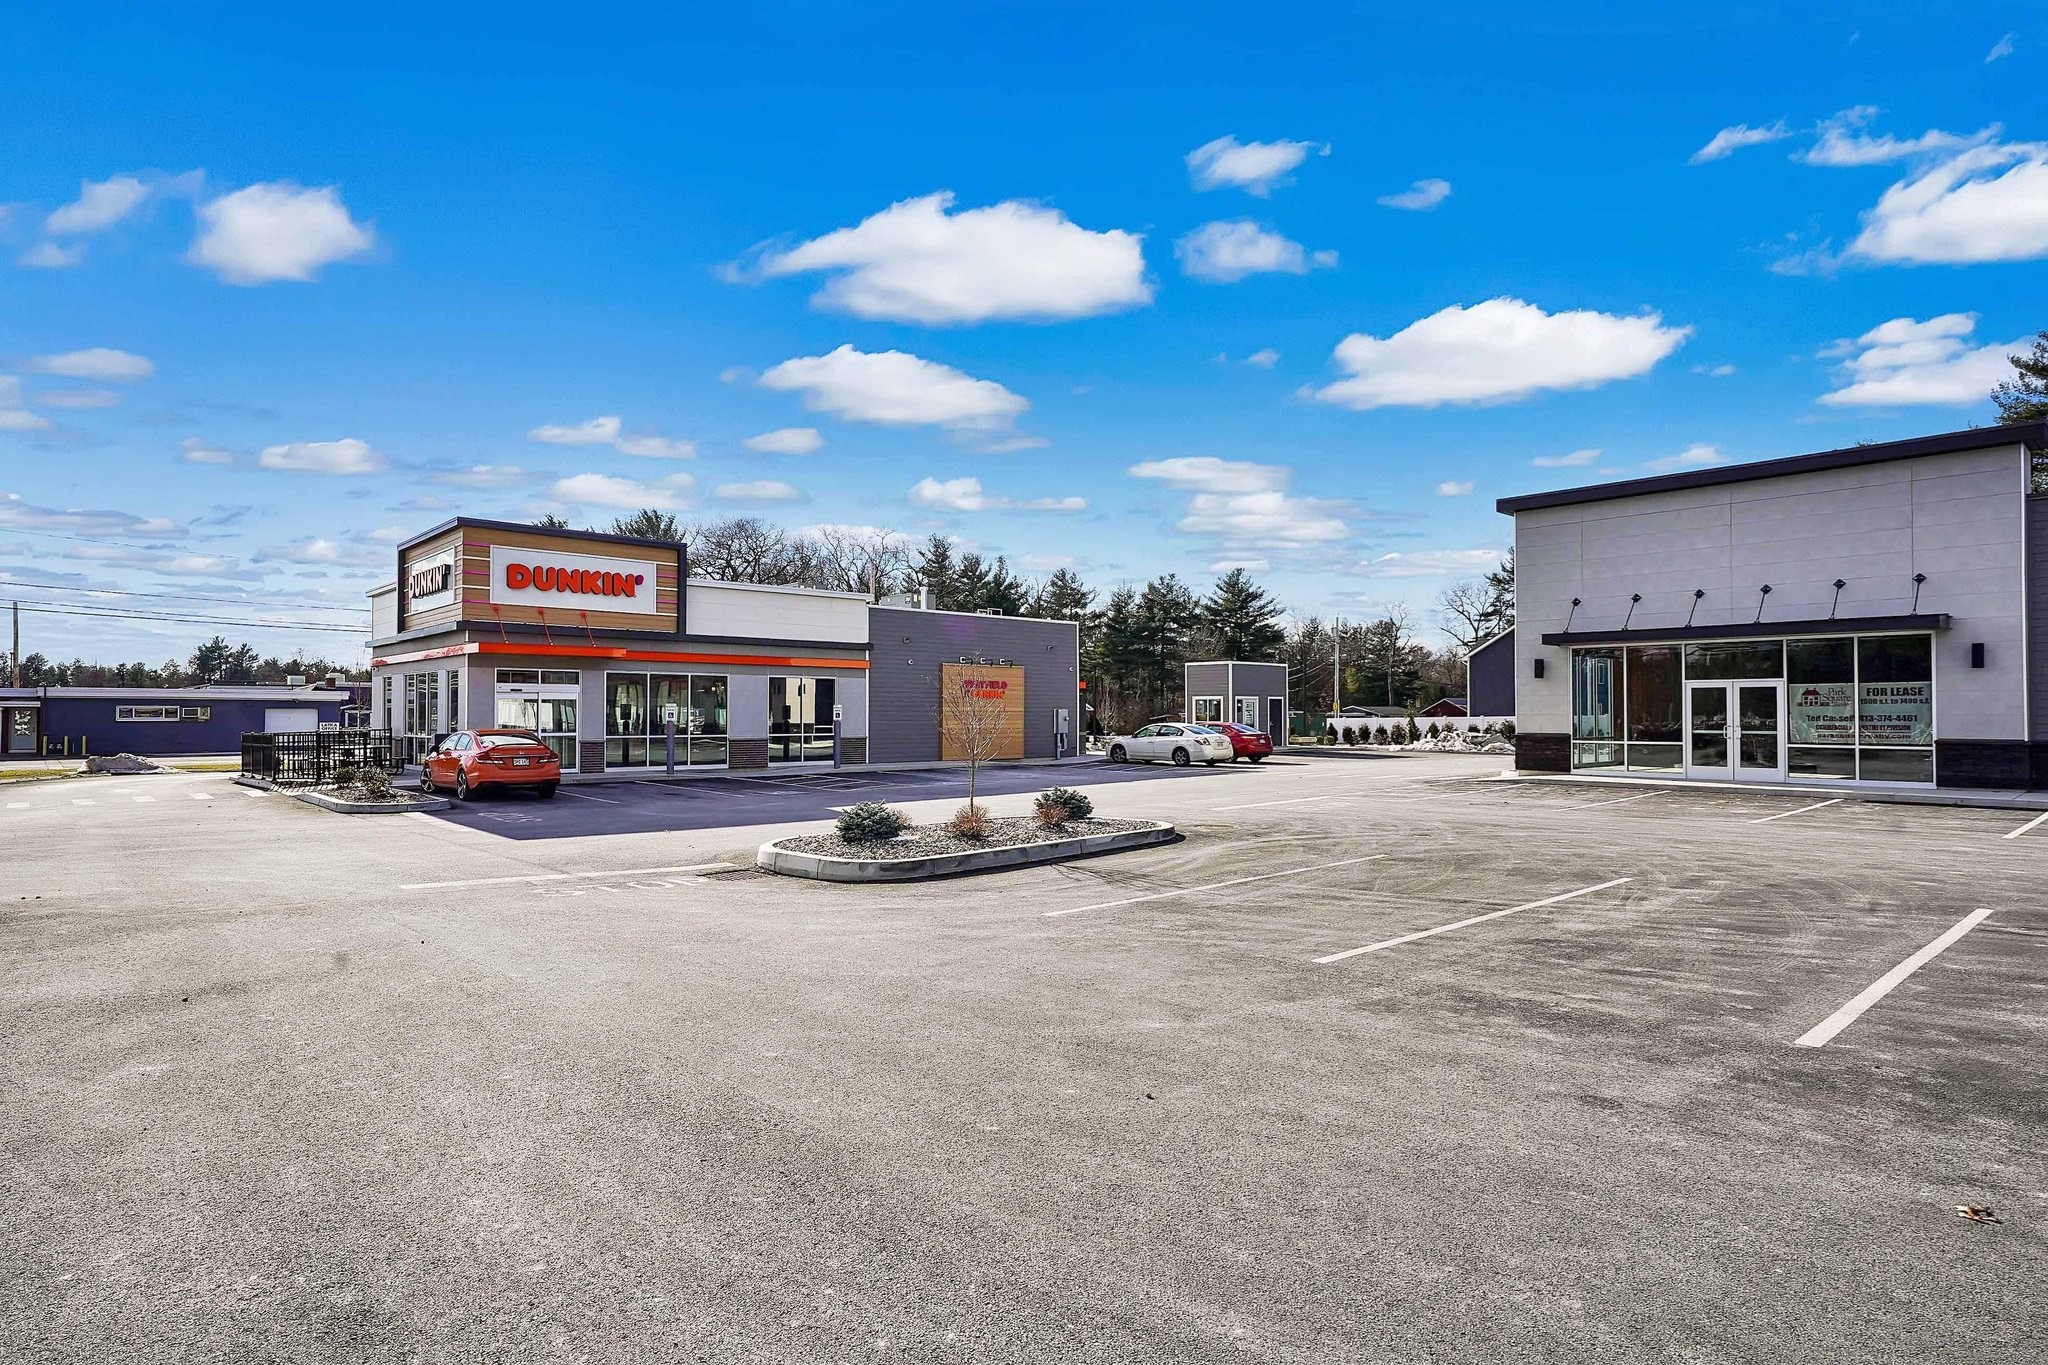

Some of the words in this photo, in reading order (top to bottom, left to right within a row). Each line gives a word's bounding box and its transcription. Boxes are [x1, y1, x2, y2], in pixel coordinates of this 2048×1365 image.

[408, 564, 451, 599] DUNKIN'
[506, 563, 645, 598] DUNKIN'
[1866, 687, 1888, 697] FOR
[1890, 686, 1925, 697] LEASE
